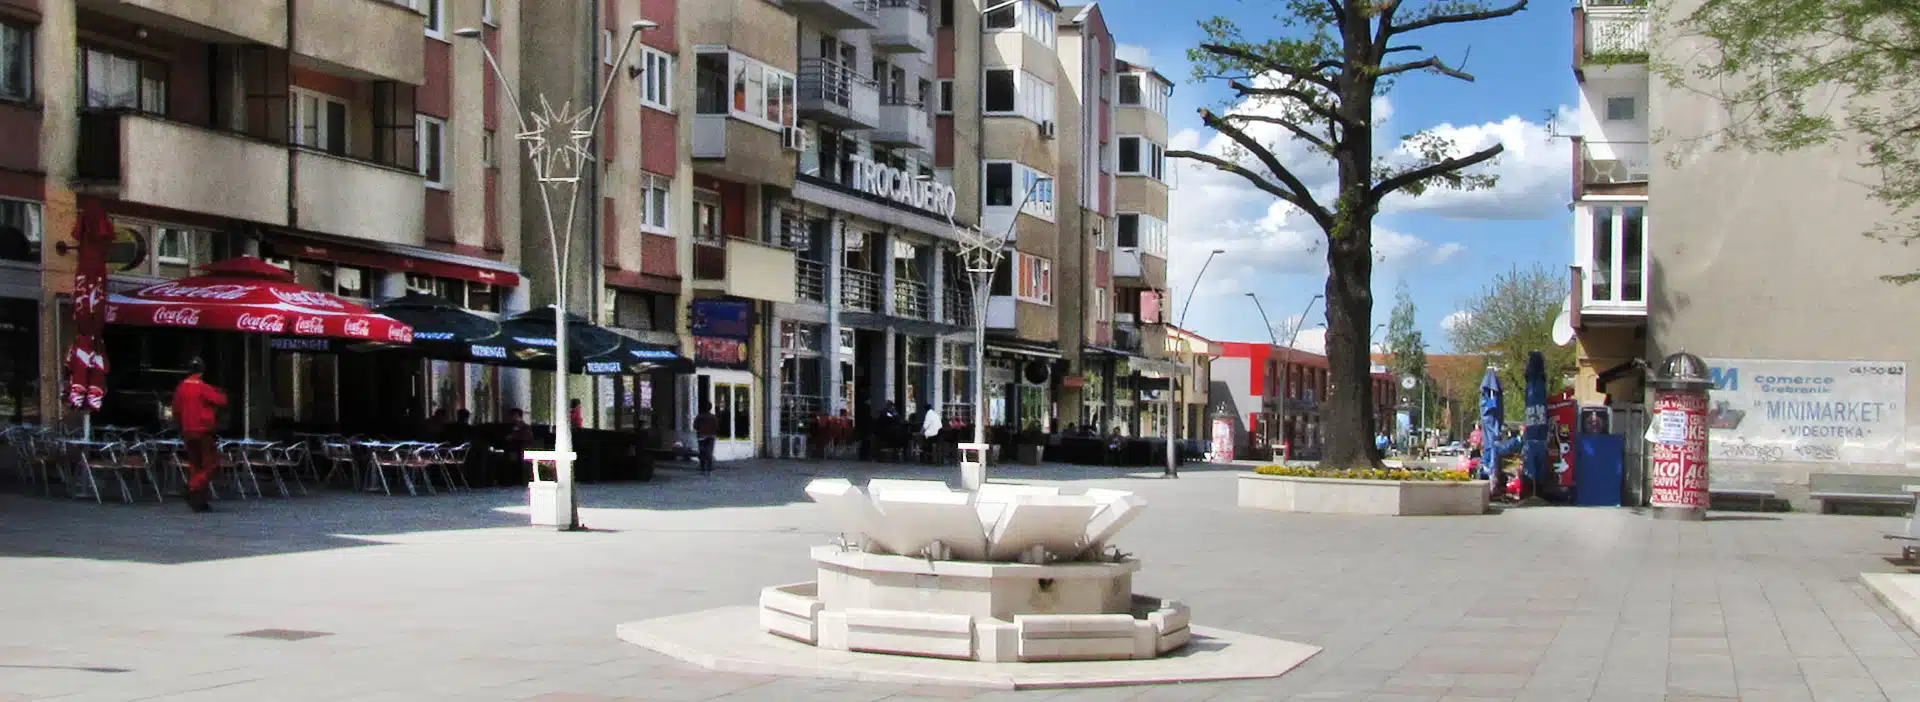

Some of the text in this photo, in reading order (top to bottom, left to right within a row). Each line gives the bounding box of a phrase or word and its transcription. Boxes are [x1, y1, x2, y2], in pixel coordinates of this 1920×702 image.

[849, 153, 956, 218] TROCADERO
[1754, 374, 1834, 385] comerce
[1788, 425, 1865, 438] VIDEOTEKA
[1653, 461, 1680, 477] ACO
